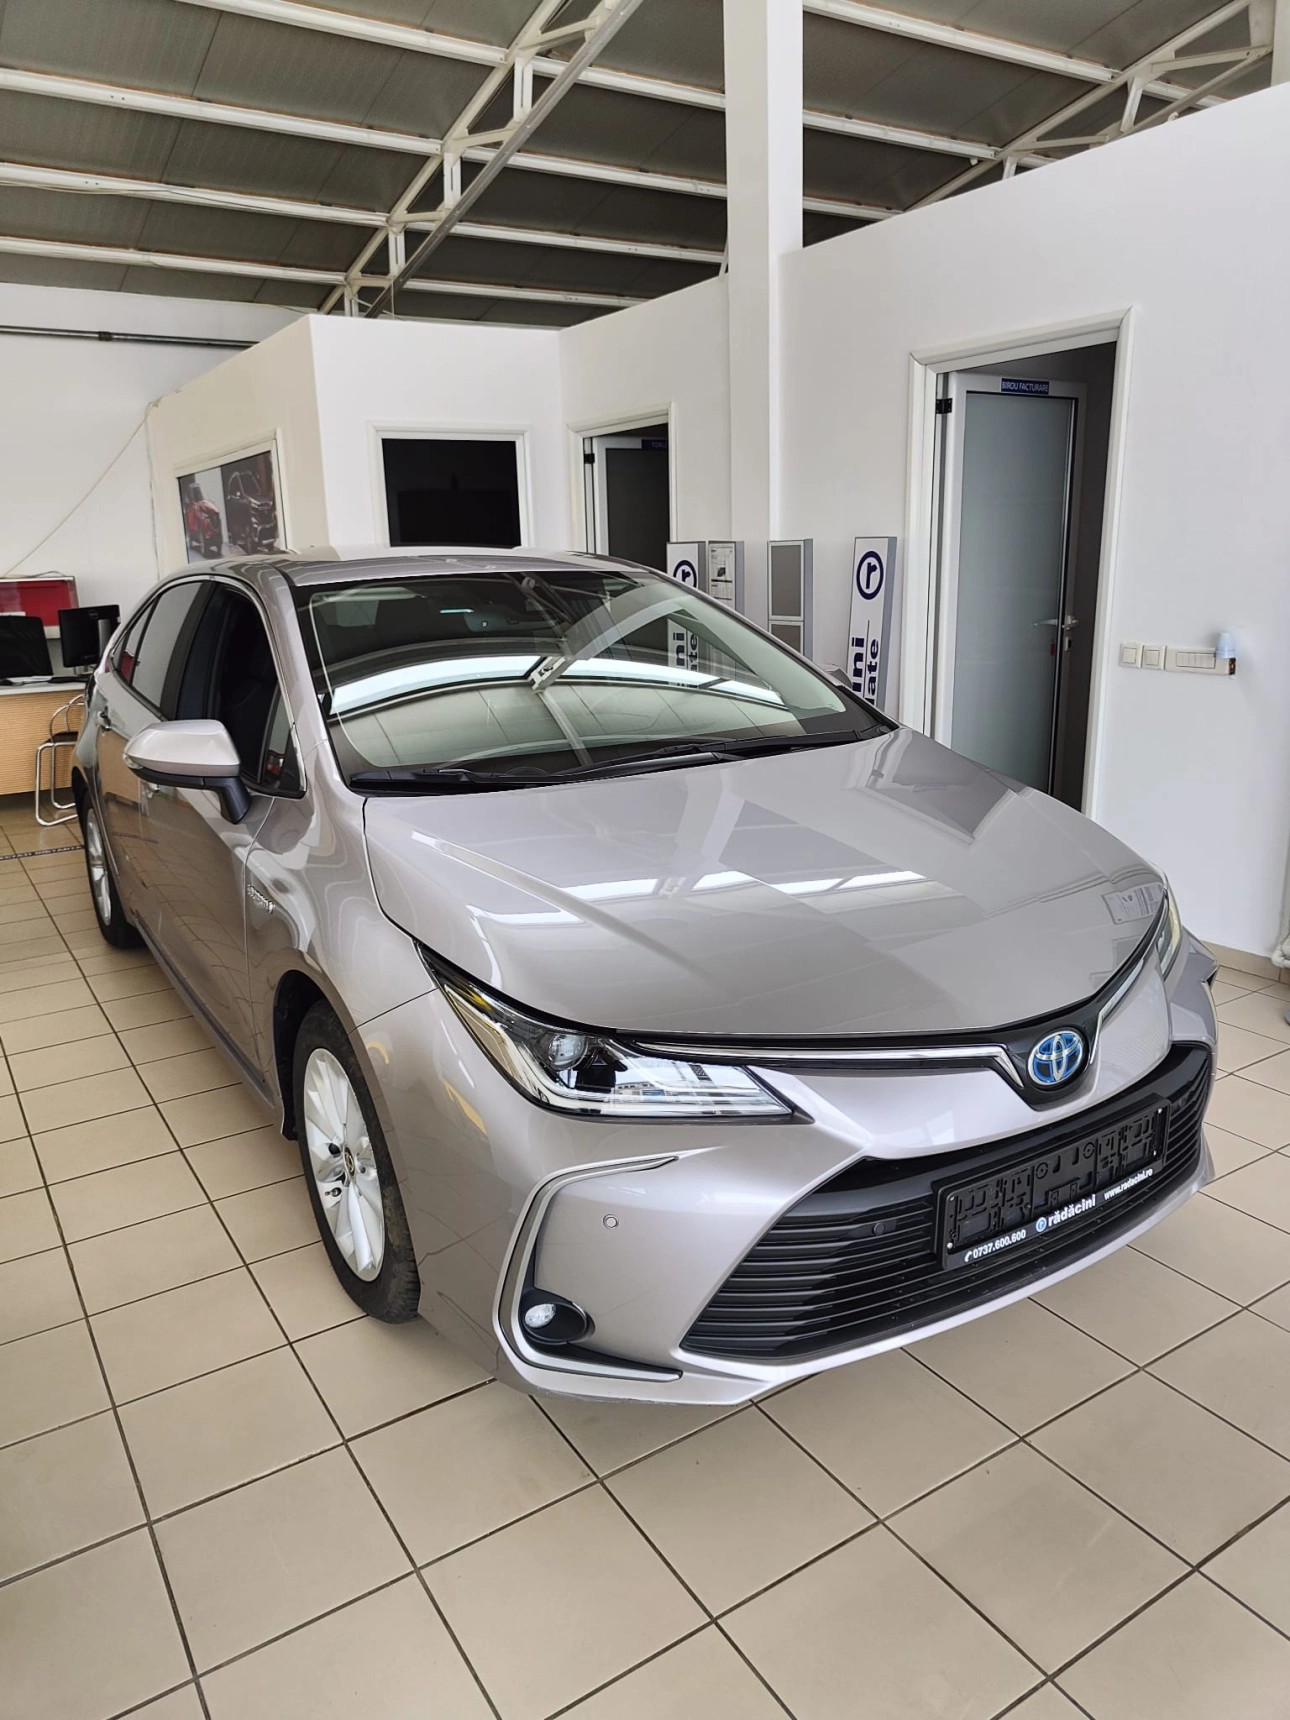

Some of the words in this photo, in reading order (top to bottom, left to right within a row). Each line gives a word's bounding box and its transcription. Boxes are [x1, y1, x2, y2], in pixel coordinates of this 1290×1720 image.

[1002, 381, 1018, 390] BIROU
[1019, 382, 1049, 392] FACTURARE
[973, 1229, 1026, 1259] 0737.600.600
[1048, 1194, 1096, 1227] rădăcini
[1104, 1168, 1153, 1201] www.radacini.ro
